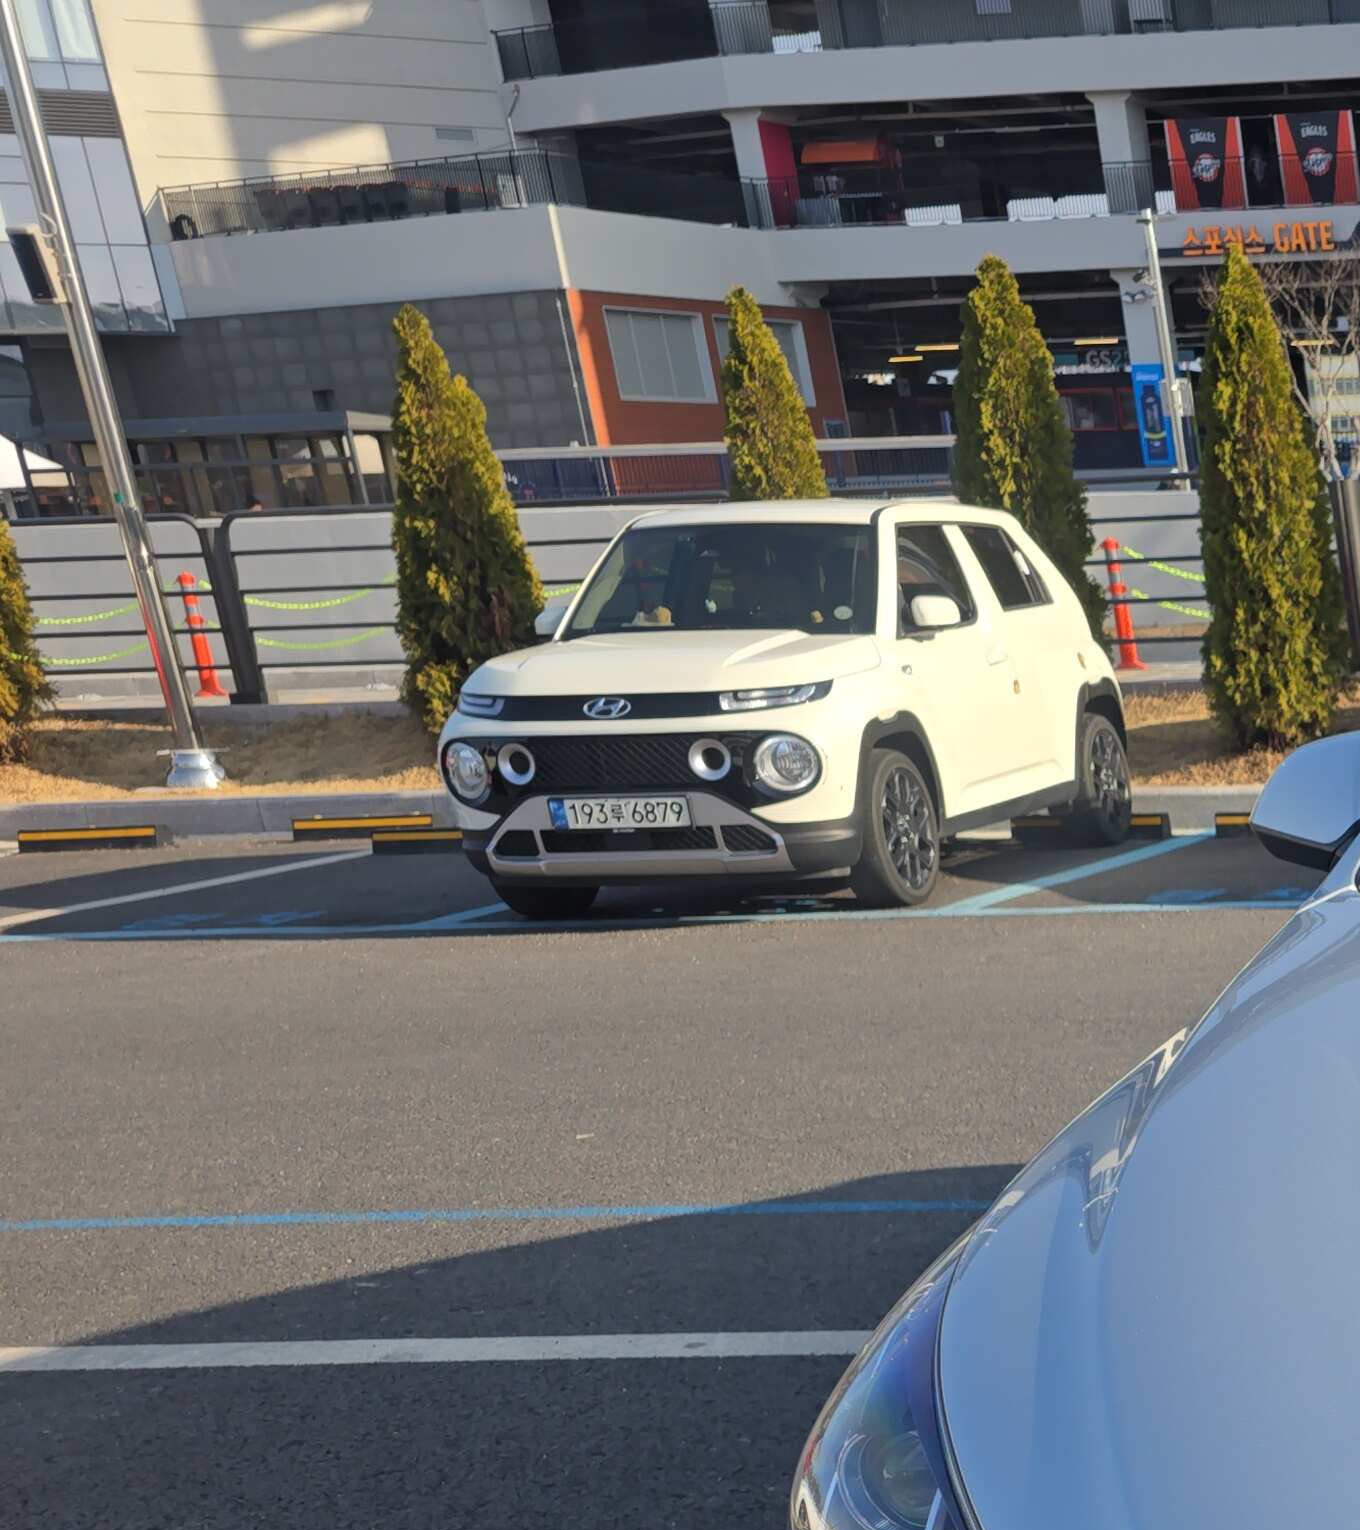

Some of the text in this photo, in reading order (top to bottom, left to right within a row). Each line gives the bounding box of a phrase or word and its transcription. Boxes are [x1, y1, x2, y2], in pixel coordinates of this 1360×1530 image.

[1190, 131, 1216, 144] EAGLES
[1300, 125, 1328, 138] EAGLES
[1273, 220, 1335, 253] GATE
[632, 801, 683, 823] 6879
